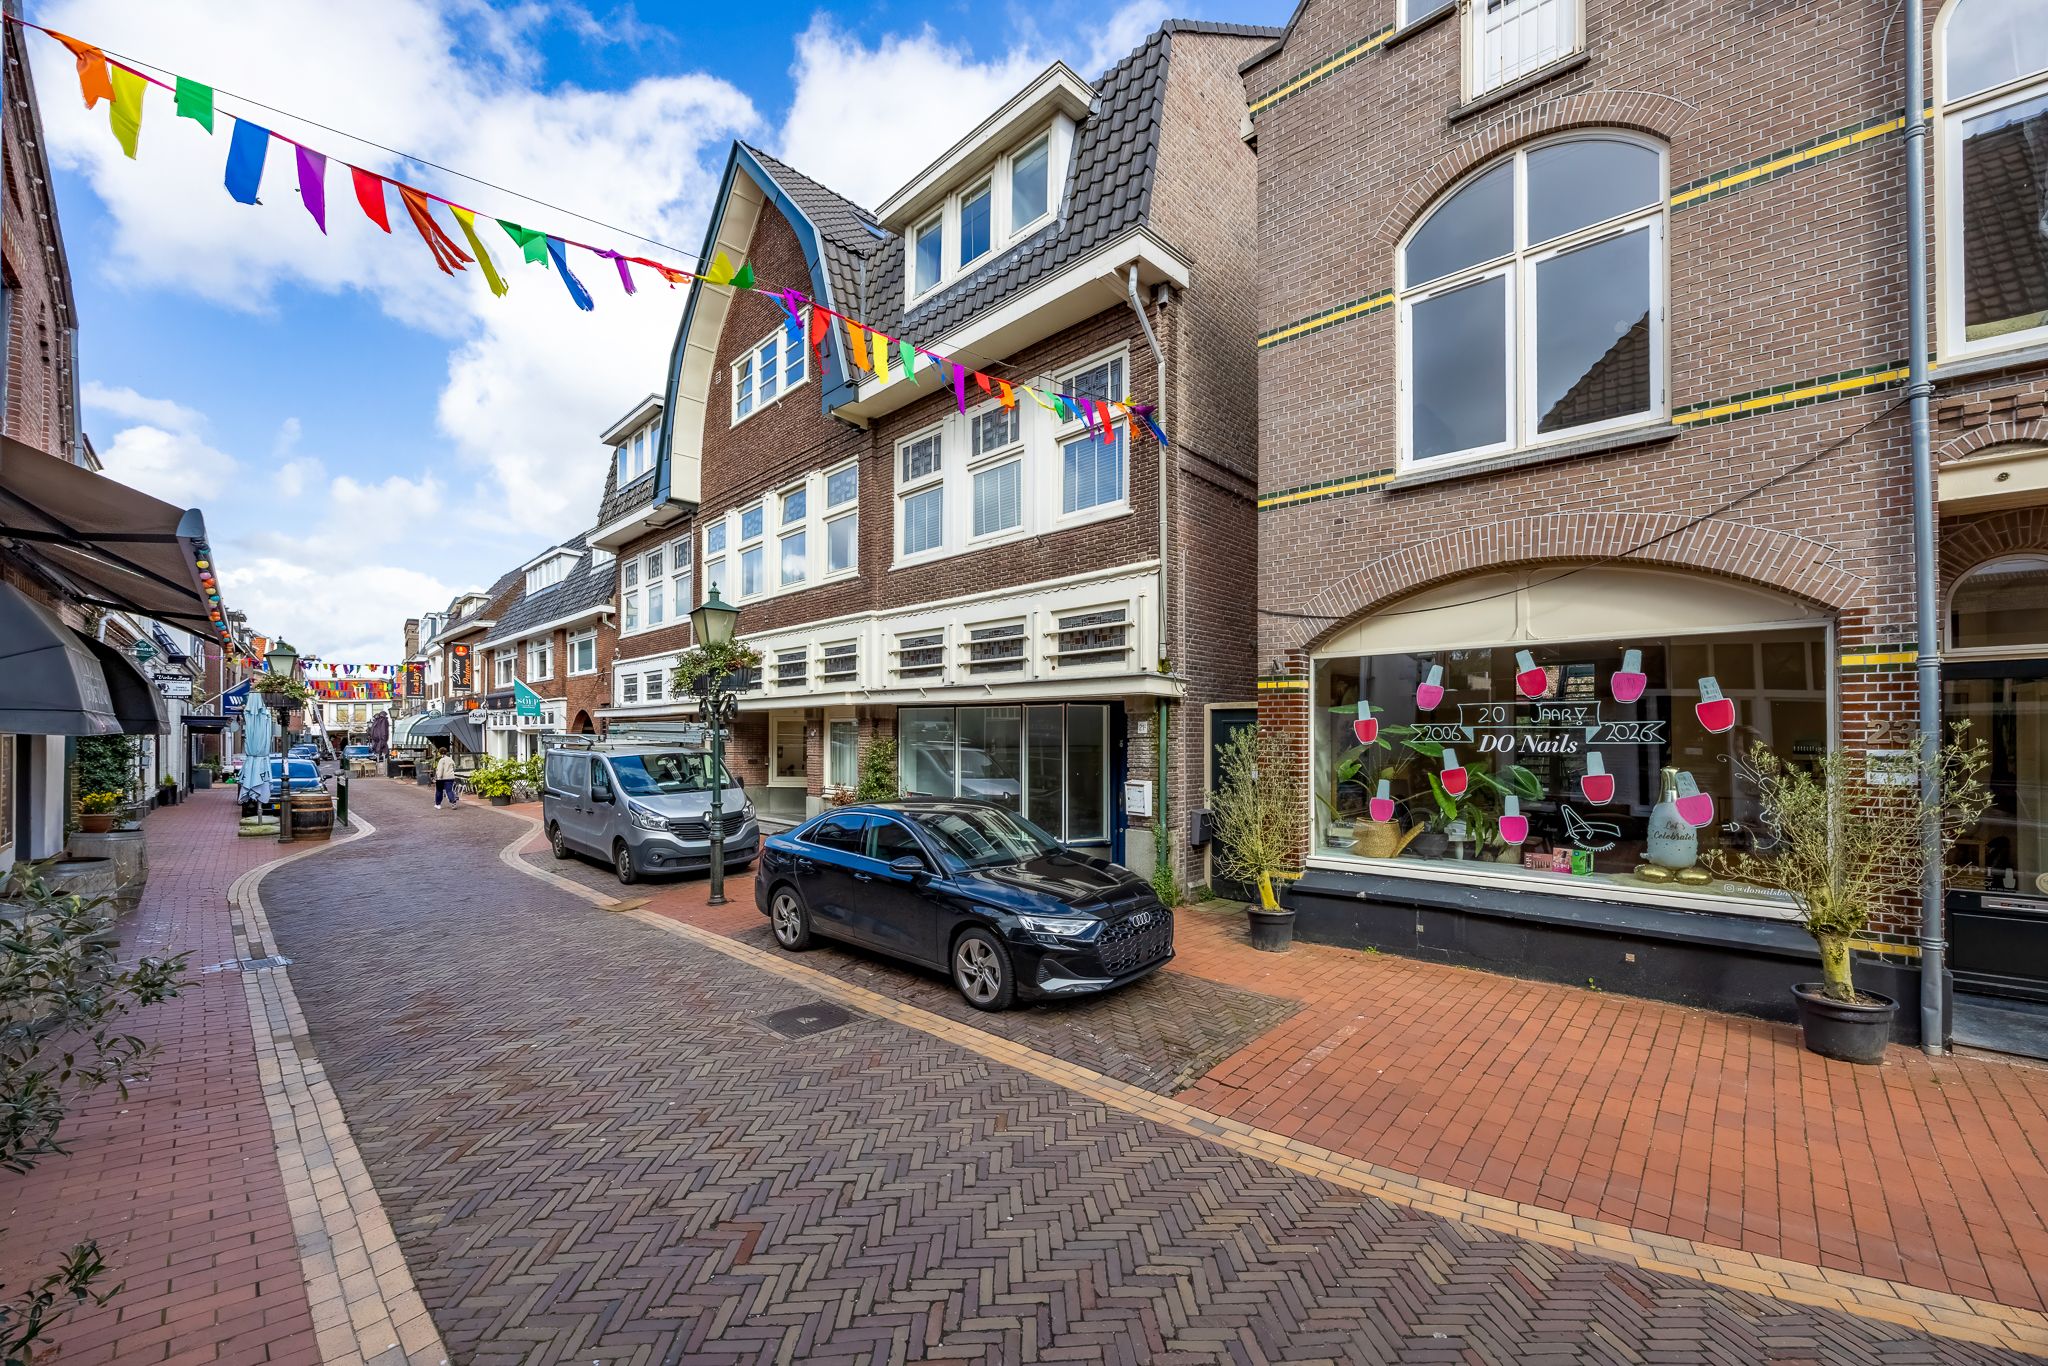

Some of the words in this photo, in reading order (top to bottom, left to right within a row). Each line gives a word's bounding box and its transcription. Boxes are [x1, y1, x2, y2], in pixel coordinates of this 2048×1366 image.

[1478, 706, 1506, 724] 20
[1423, 724, 1462, 742] 2006
[1604, 723, 1653, 742] 2026
[1867, 720, 1918, 745] 23
[1477, 734, 1516, 753] DO
[1518, 734, 1578, 753] Nails
